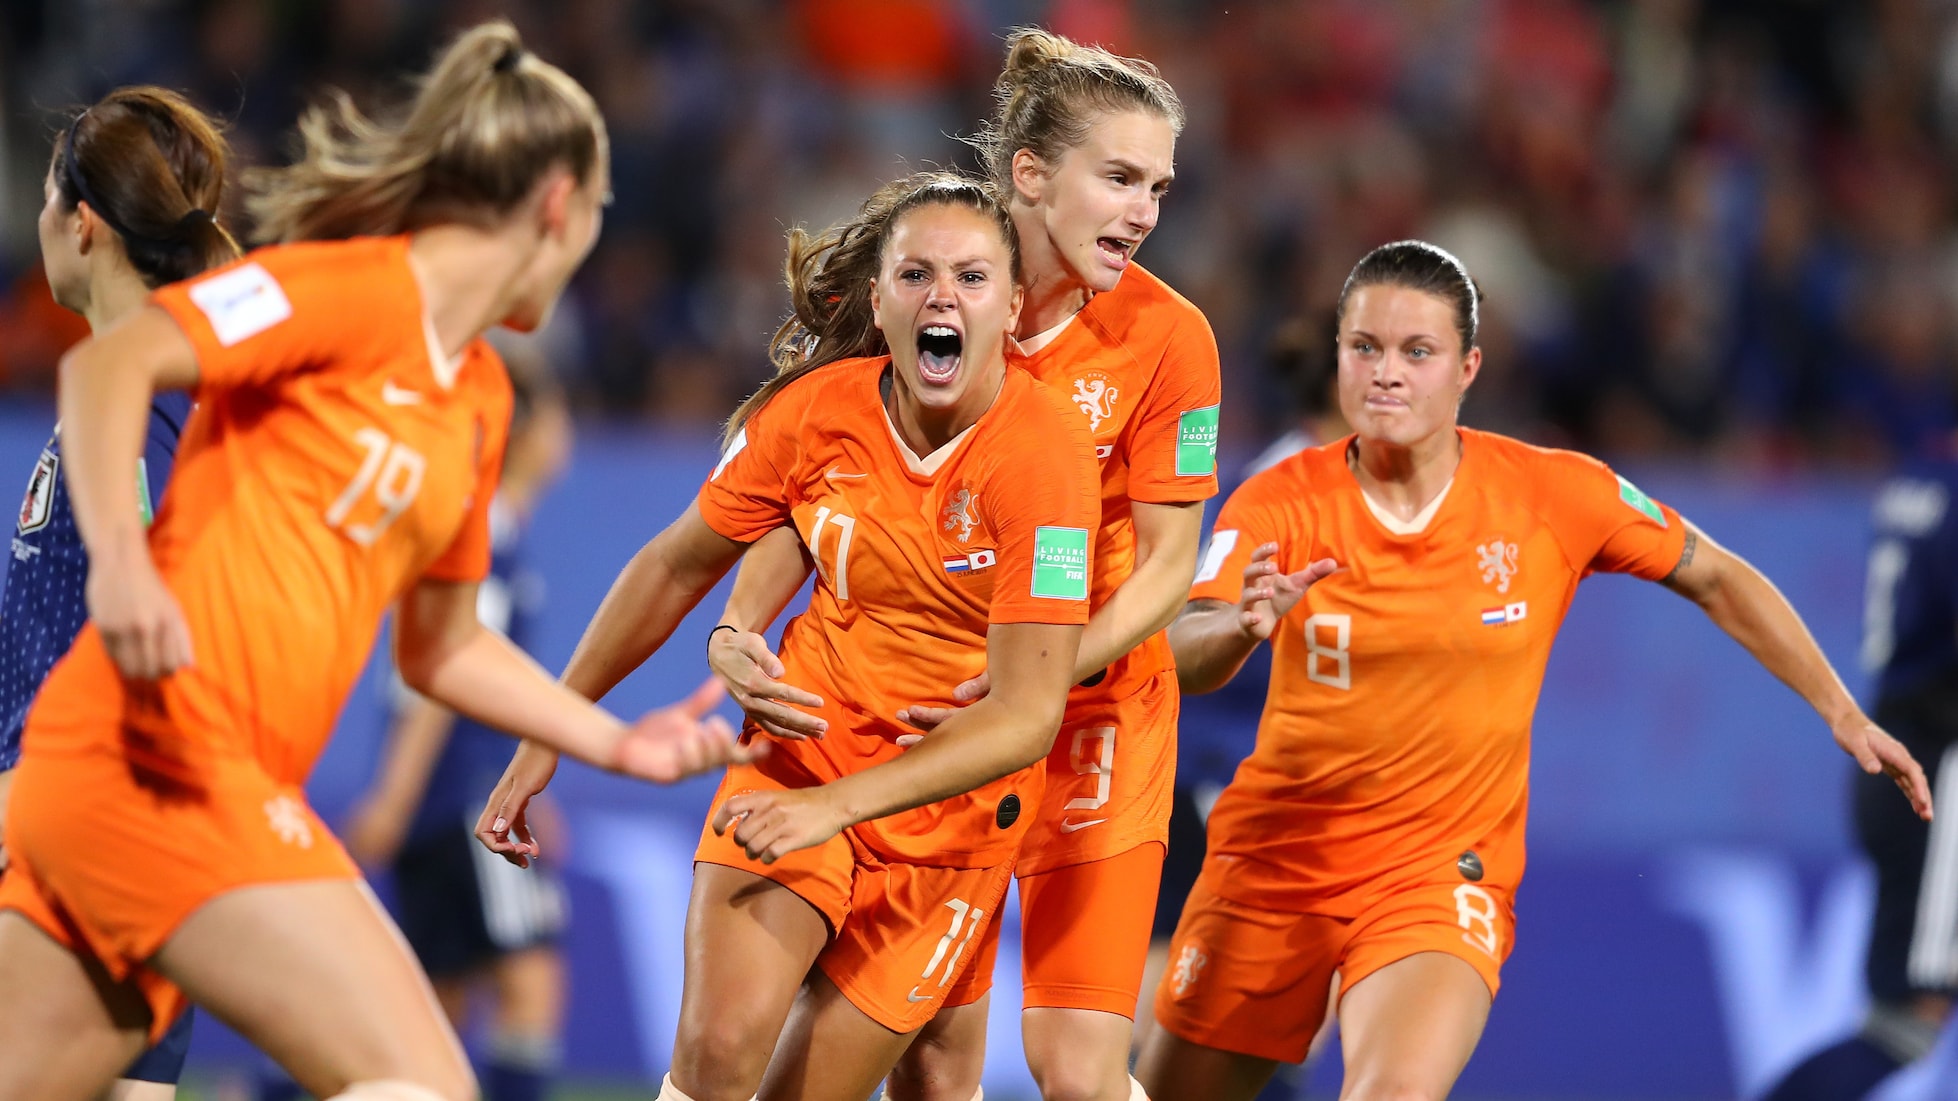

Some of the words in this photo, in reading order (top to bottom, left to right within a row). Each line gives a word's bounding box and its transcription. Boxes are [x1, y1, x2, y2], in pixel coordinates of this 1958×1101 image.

[1183, 425, 1217, 434] LIVI
[326, 426, 426, 546] 19
[1040, 546, 1084, 556] LIVING
[1040, 553, 1084, 564] FOOTBALL
[1066, 570, 1083, 580] FIFA
[1304, 612, 1351, 691] 8
[1063, 726, 1116, 810] 9
[921, 897, 984, 988] 11
